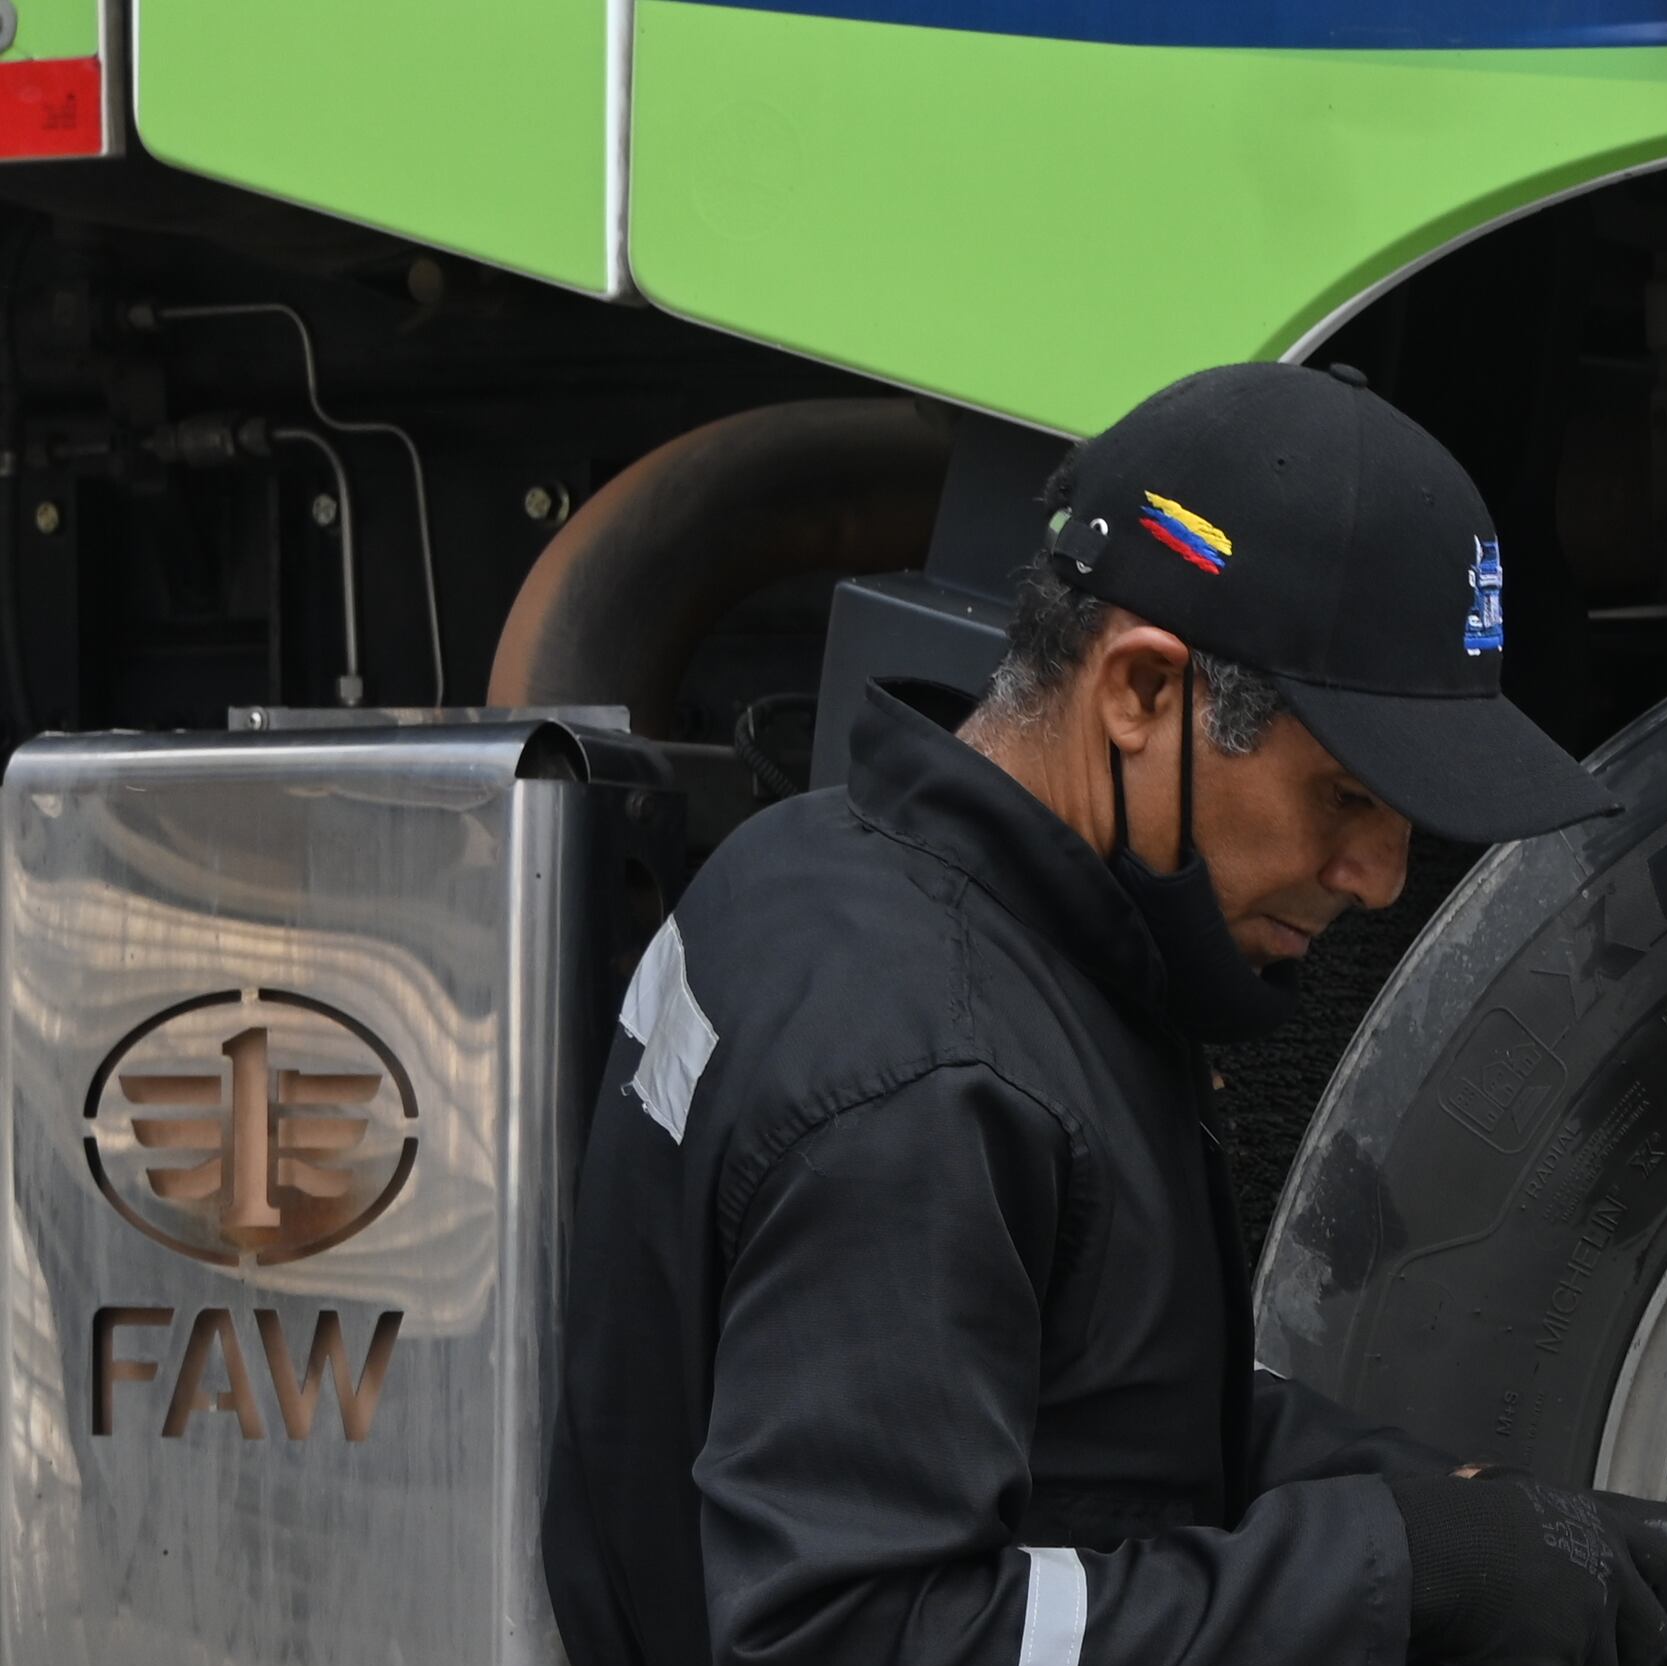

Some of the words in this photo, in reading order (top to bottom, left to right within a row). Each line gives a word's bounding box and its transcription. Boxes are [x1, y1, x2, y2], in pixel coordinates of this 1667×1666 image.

[1524, 1122, 1583, 1200] RADIAL
[1536, 1192, 1629, 1355] MICHELIN
[91, 1306, 405, 1443] FAW
